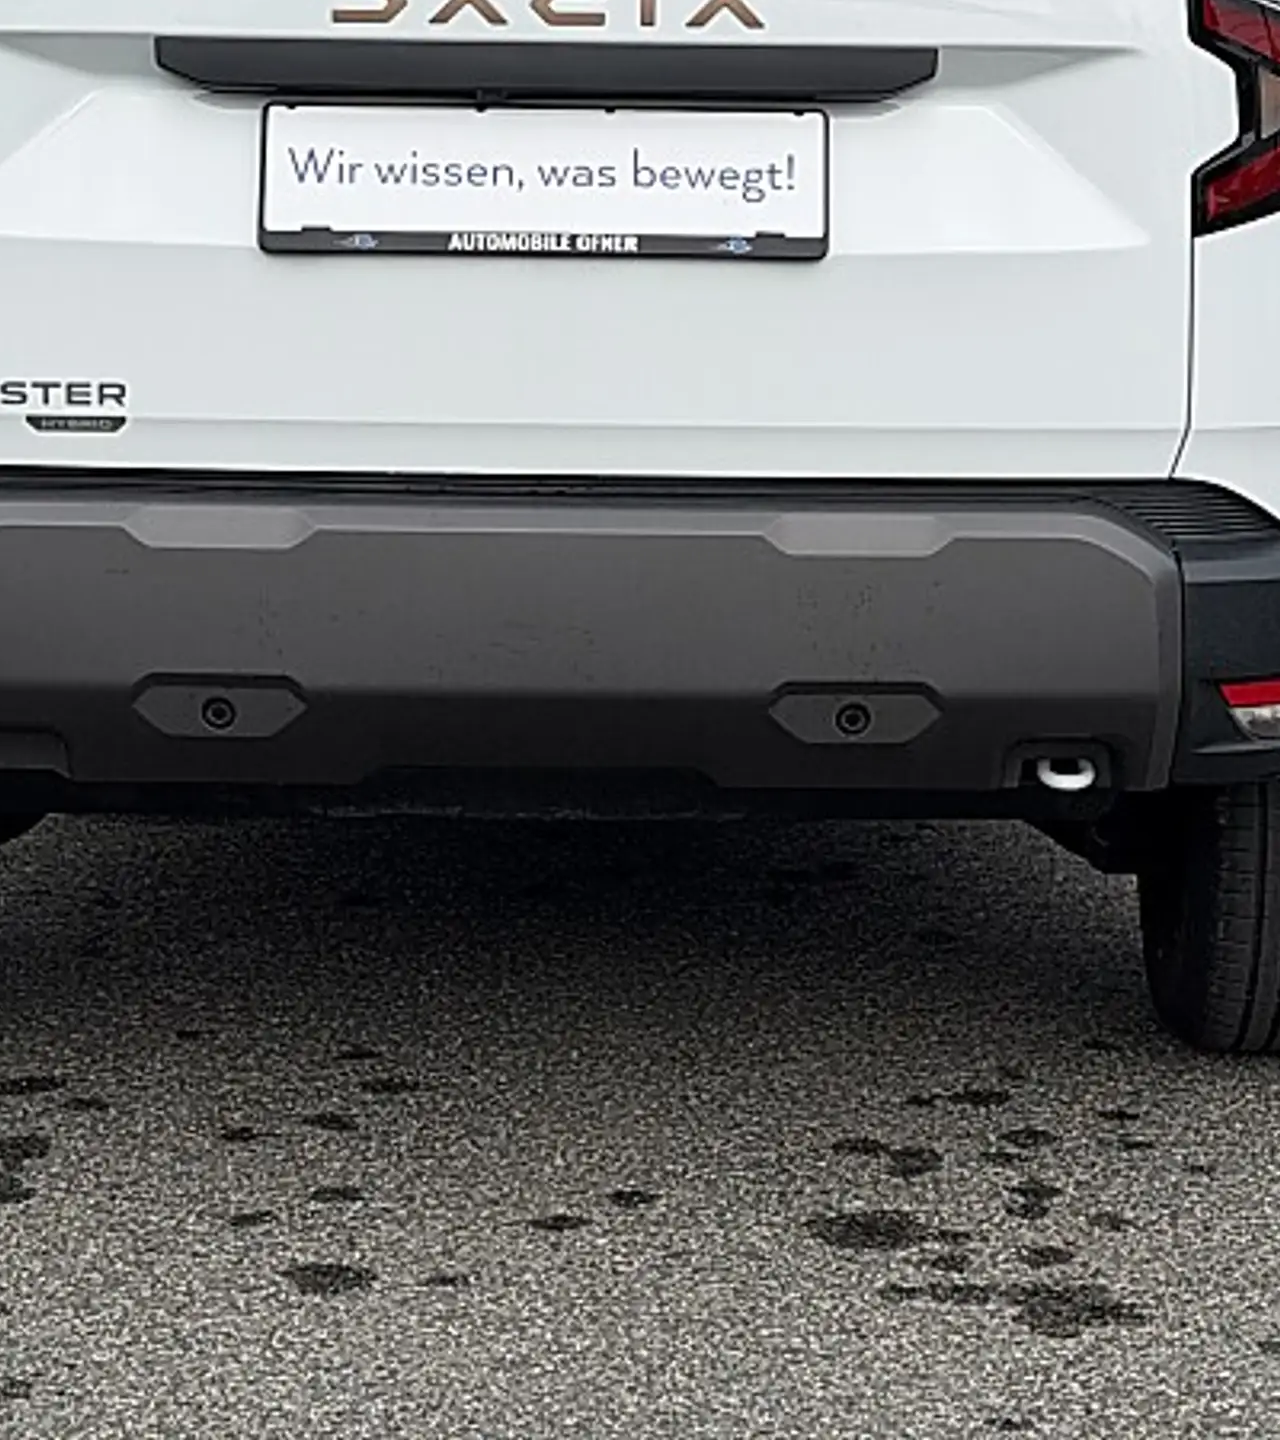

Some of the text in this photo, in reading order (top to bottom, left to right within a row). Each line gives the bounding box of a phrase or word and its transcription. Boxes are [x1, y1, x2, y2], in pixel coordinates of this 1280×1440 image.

[287, 146, 798, 204] Wir wissen, was bewegt!
[447, 233, 640, 253] AUTOMOBILE OFNER
